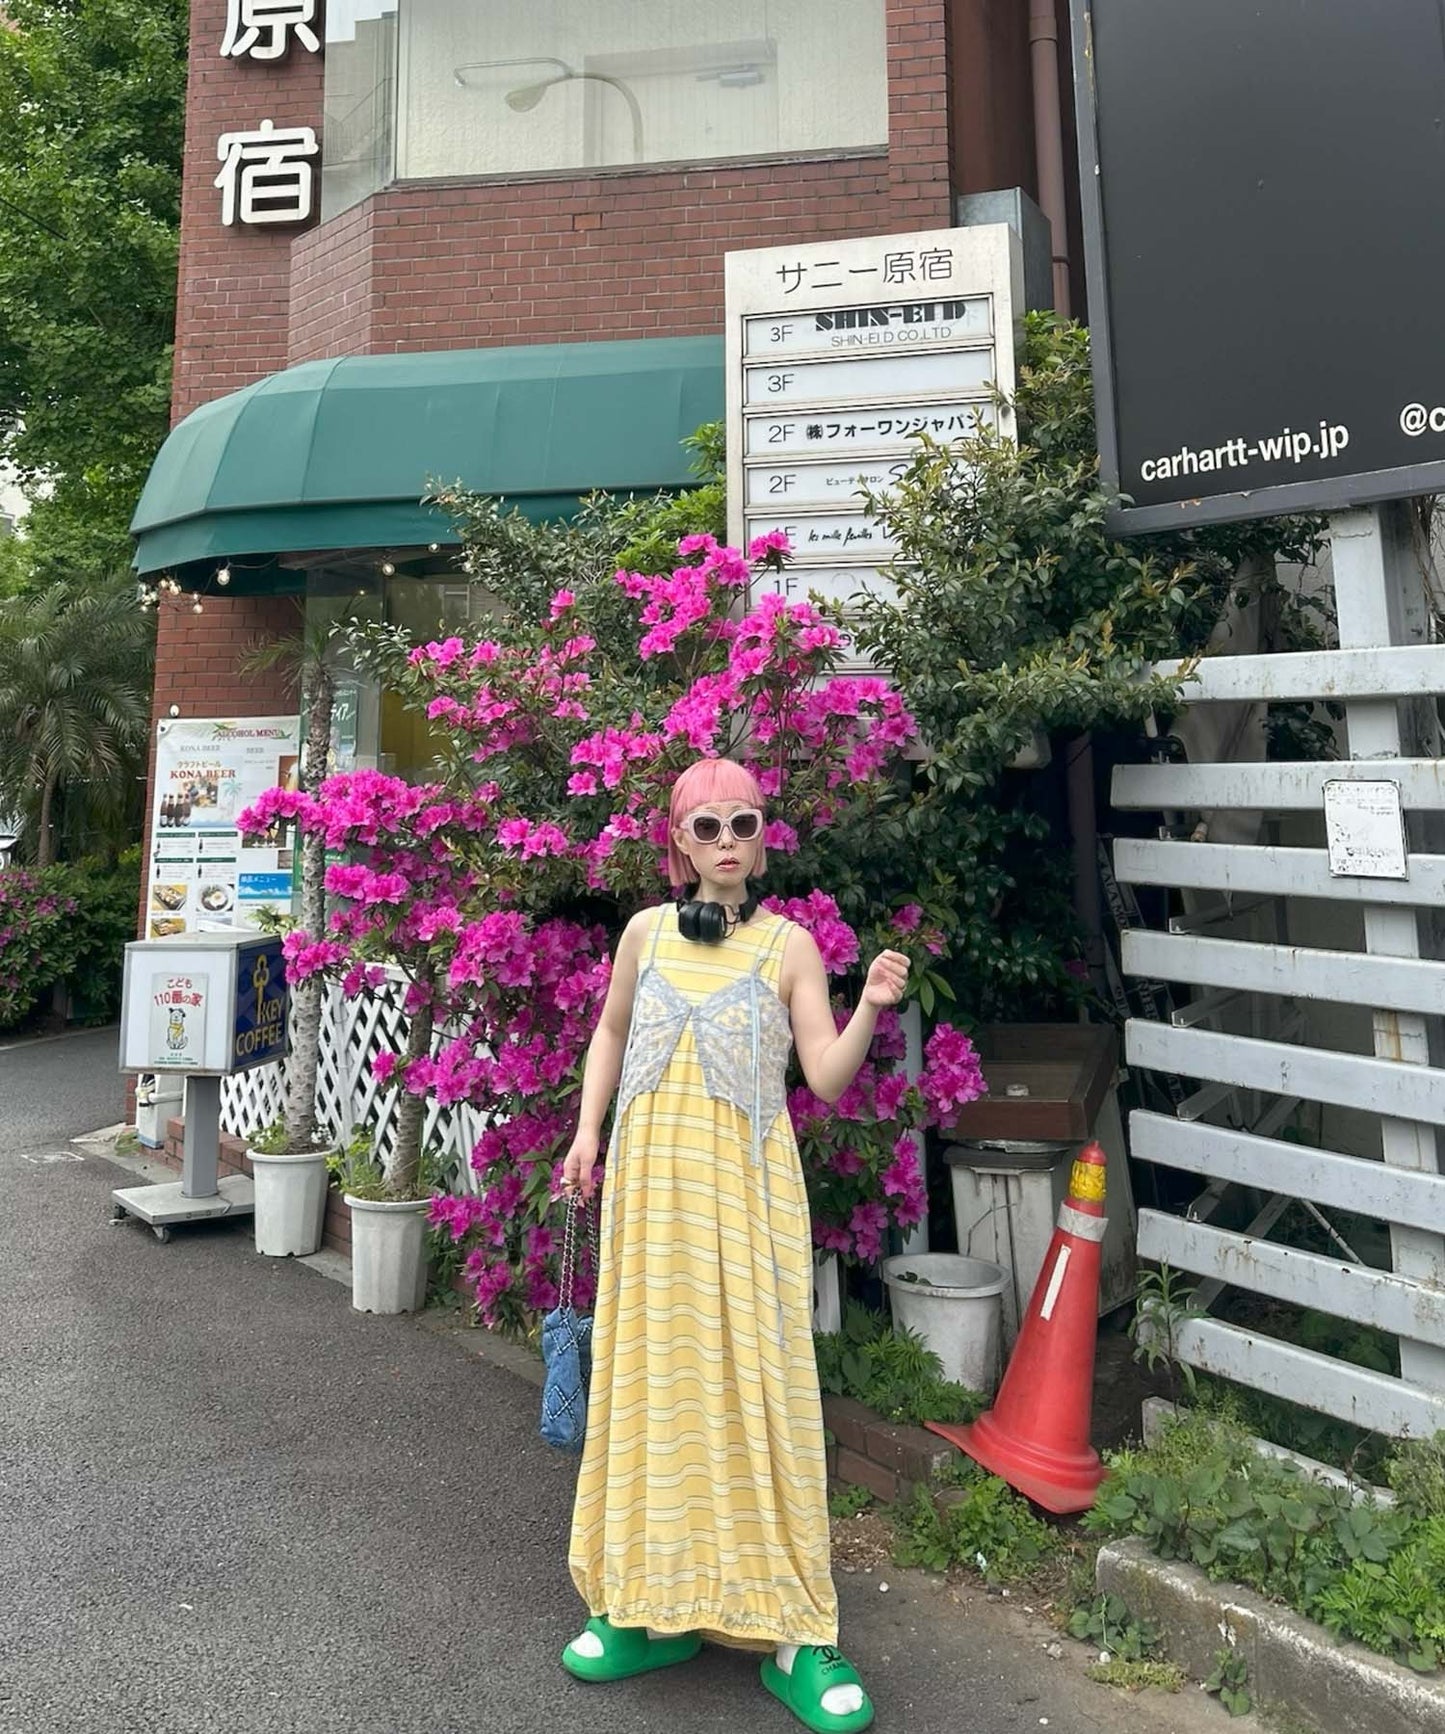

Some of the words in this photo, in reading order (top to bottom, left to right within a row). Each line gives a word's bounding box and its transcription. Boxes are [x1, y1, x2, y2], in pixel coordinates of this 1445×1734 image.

[776, 247, 953, 294] サニー原宿
[770, 324, 794, 343] 3F
[767, 373, 795, 393] 3F
[768, 423, 795, 443] 2F
[1140, 420, 1350, 482] carhartt-wip.jp
[769, 474, 796, 493] 2F
[170, 769, 204, 780] KONA
[206, 769, 236, 779] BEER
[167, 977, 193, 989] こども
[154, 990, 203, 1007] 110番の家
[259, 997, 284, 1025] KEY
[236, 1022, 283, 1057] COFFEE
